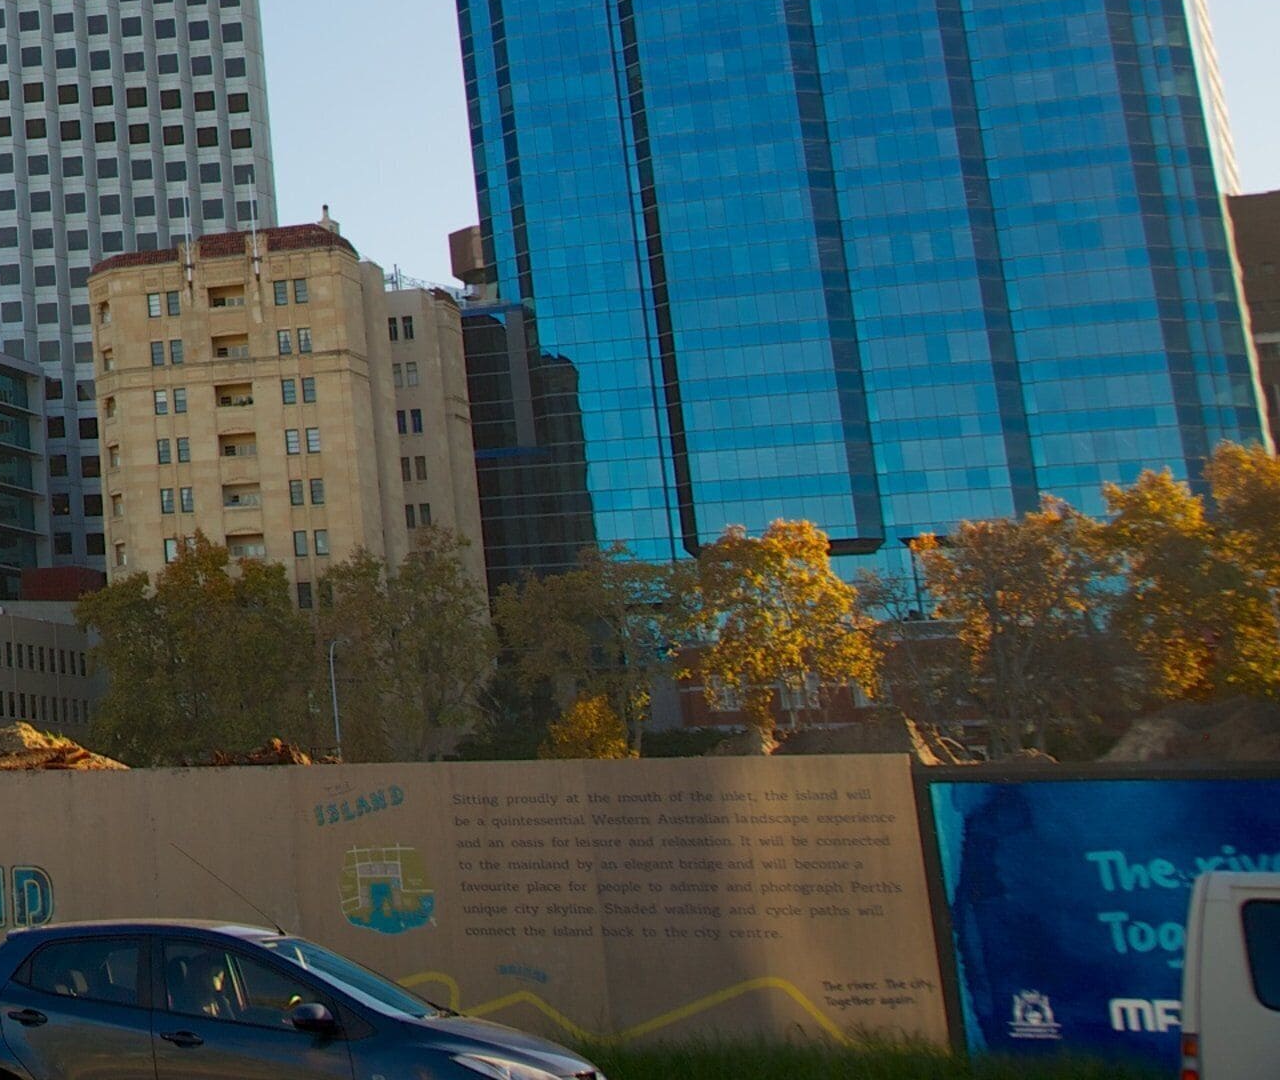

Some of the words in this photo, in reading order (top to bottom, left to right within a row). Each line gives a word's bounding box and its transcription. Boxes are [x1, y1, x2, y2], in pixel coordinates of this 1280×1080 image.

[453, 793, 499, 806] Sitting
[507, 792, 557, 806] proudly
[566, 794, 579, 803] at
[587, 792, 608, 803] the
[618, 792, 658, 802] mouth
[665, 791, 682, 802] of
[690, 790, 712, 801] the
[765, 790, 788, 800] the
[795, 789, 837, 800] island
[846, 789, 871, 800] will
[314, 785, 404, 826] ISLAND
[455, 814, 470, 825] be
[492, 814, 585, 828] quintessential
[592, 814, 649, 825] Western
[658, 813, 729, 825] Australian
[735, 813, 808, 826] landscape
[817, 814, 896, 826] experience
[457, 837, 481, 848] and
[488, 839, 504, 848] an
[511, 838, 544, 848] oasis
[552, 837, 569, 847] for
[576, 837, 621, 847] leisure
[628, 836, 654, 847] and
[760, 835, 784, 846] will
[792, 835, 808, 846] be
[817, 835, 890, 846] connected
[459, 861, 472, 870] to
[479, 860, 500, 870] the
[508, 860, 569, 870] mainland
[577, 860, 592, 872] by
[600, 861, 618, 870] an
[625, 860, 673, 872] elegant
[679, 859, 723, 871] bridge
[728, 859, 753, 869] and
[762, 859, 787, 869] will
[795, 859, 849, 869] become
[1085, 850, 1181, 891] The
[461, 881, 519, 892] favourite
[527, 881, 561, 894] place
[569, 881, 586, 892] for
[598, 882, 640, 894] people
[649, 883, 662, 892] to
[670, 882, 718, 892] admire
[727, 881, 752, 892] and
[760, 881, 844, 895] photograph
[851, 881, 903, 892] Perth's
[463, 905, 507, 917] unique
[514, 904, 540, 917] city
[604, 903, 657, 914] Shaded
[665, 904, 721, 918] walking
[729, 904, 755, 915] and
[766, 904, 801, 918] cycle
[810, 904, 850, 917] paths
[858, 905, 884, 916] will
[465, 926, 516, 936] connect
[524, 926, 545, 936] the
[553, 925, 593, 936] island
[602, 925, 635, 936] back
[643, 927, 657, 936] to
[664, 925, 688, 936] the
[695, 926, 720, 939] city
